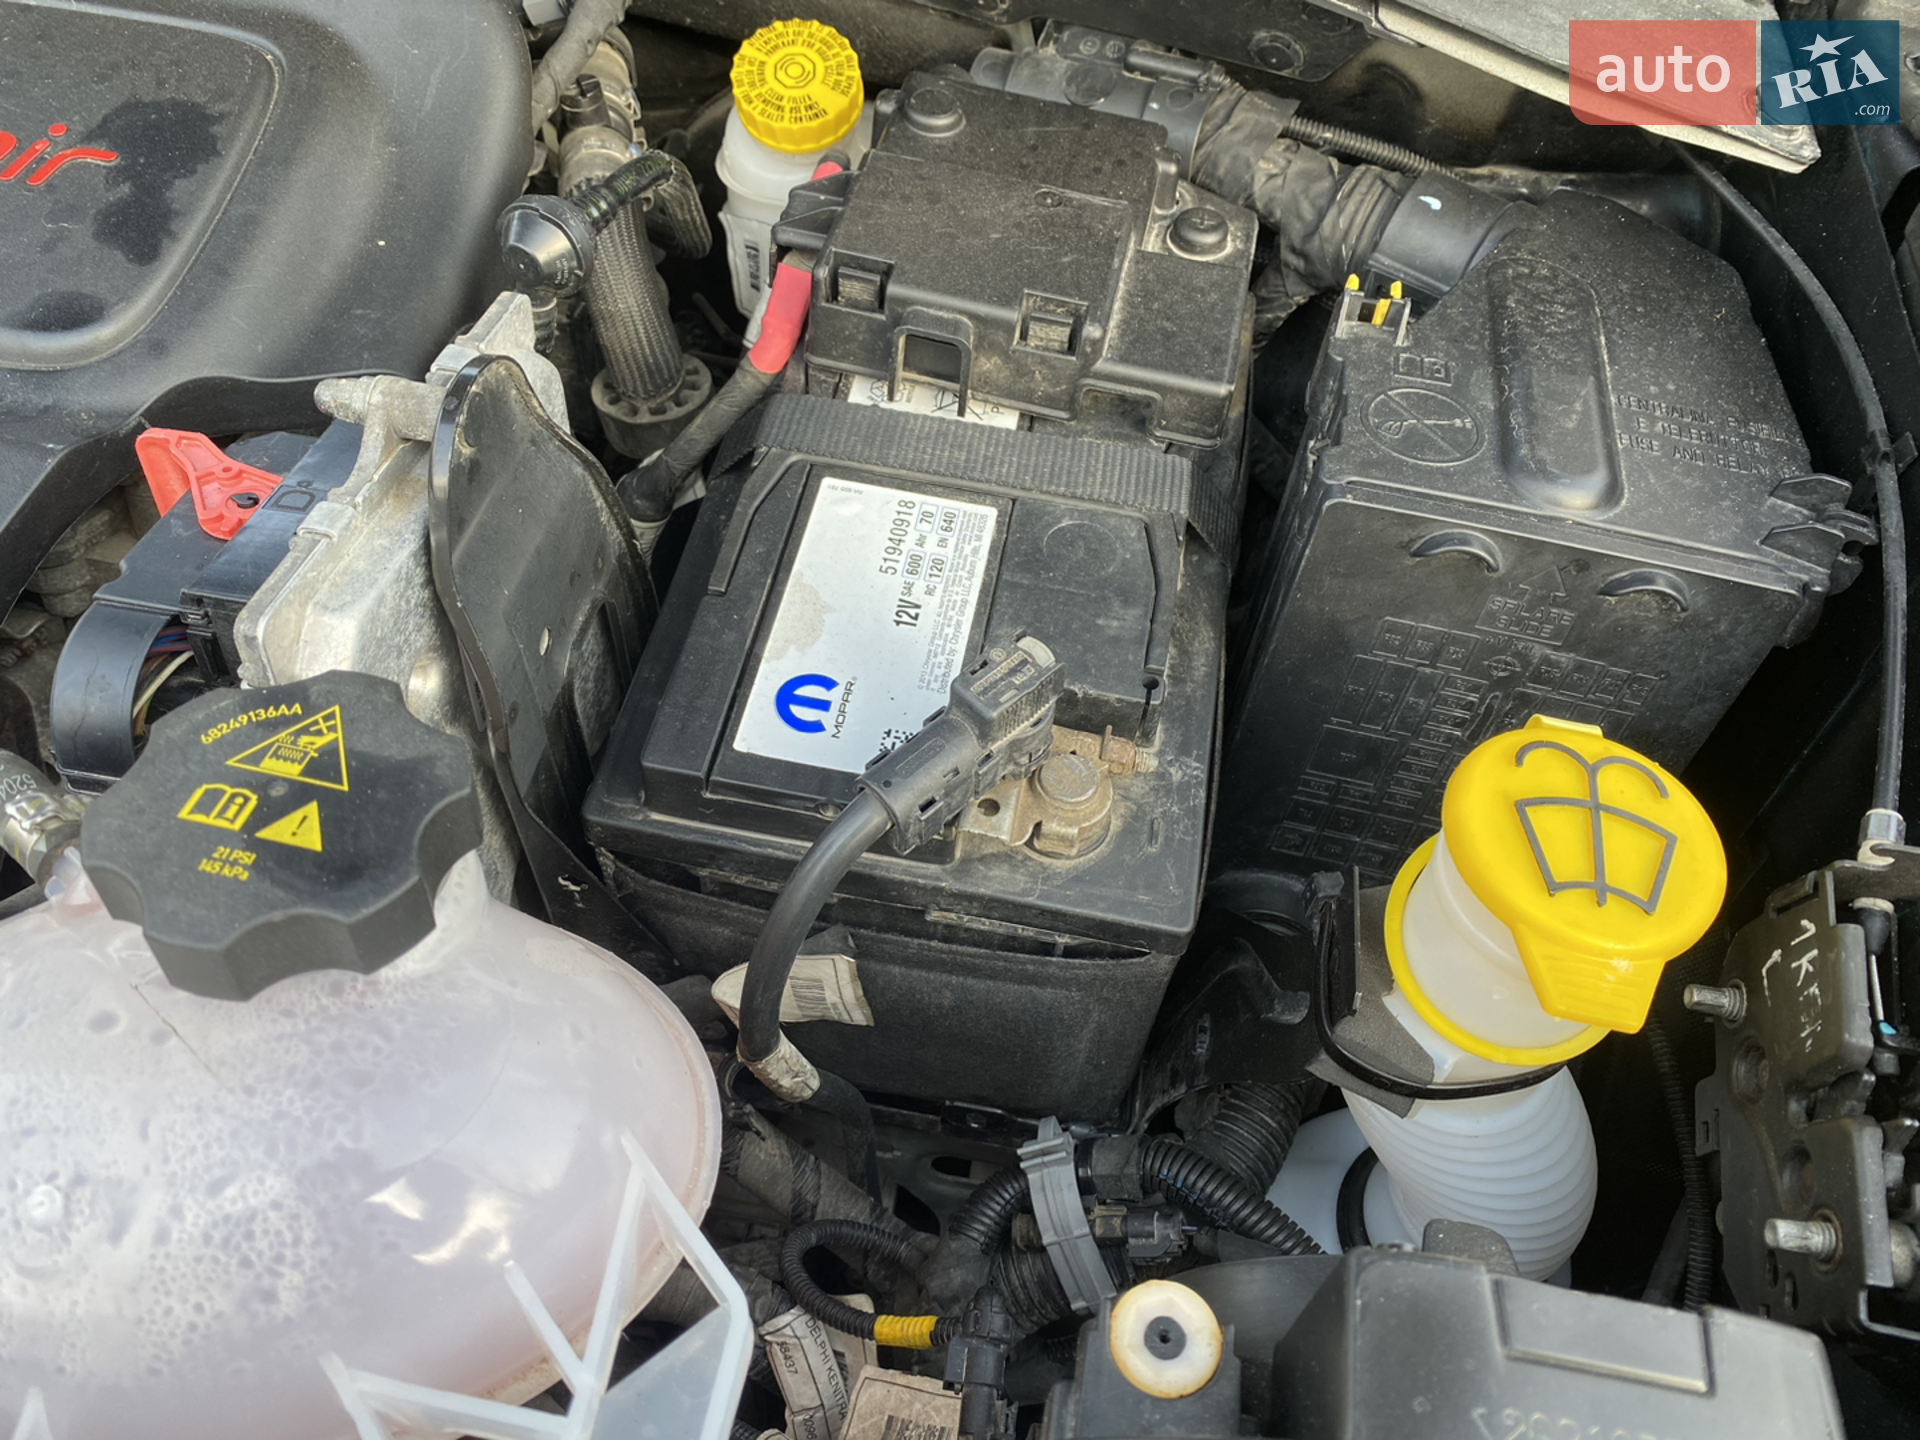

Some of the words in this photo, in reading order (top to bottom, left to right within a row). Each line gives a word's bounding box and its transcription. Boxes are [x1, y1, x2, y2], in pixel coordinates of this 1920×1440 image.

[1672, 444, 1705, 466] AND
[919, 510, 934, 525] 70
[940, 511, 957, 533] 640
[879, 499, 916, 576] 51940918
[914, 533, 928, 549] Ahr
[936, 536, 949, 549] EN
[905, 553, 923, 576] 600
[928, 557, 945, 579] 120
[962, 558, 978, 582] Auburn
[900, 579, 915, 598] SAE
[924, 583, 937, 597] RC
[893, 598, 922, 627] 12V
[955, 596, 969, 617] Group
[1487, 596, 1576, 626] SFILARE
[948, 617, 965, 645] Chrysler
[1495, 614, 1555, 638] SLIDE
[936, 657, 954, 694] Distributed
[831, 680, 857, 739] MOPAR
[200, 702, 303, 745] 68249136AA
[229, 849, 257, 866] PSI
[221, 863, 250, 881] kPa
[804, 1316, 833, 1367] DELPHI
[826, 1362, 848, 1421] KENITRA
